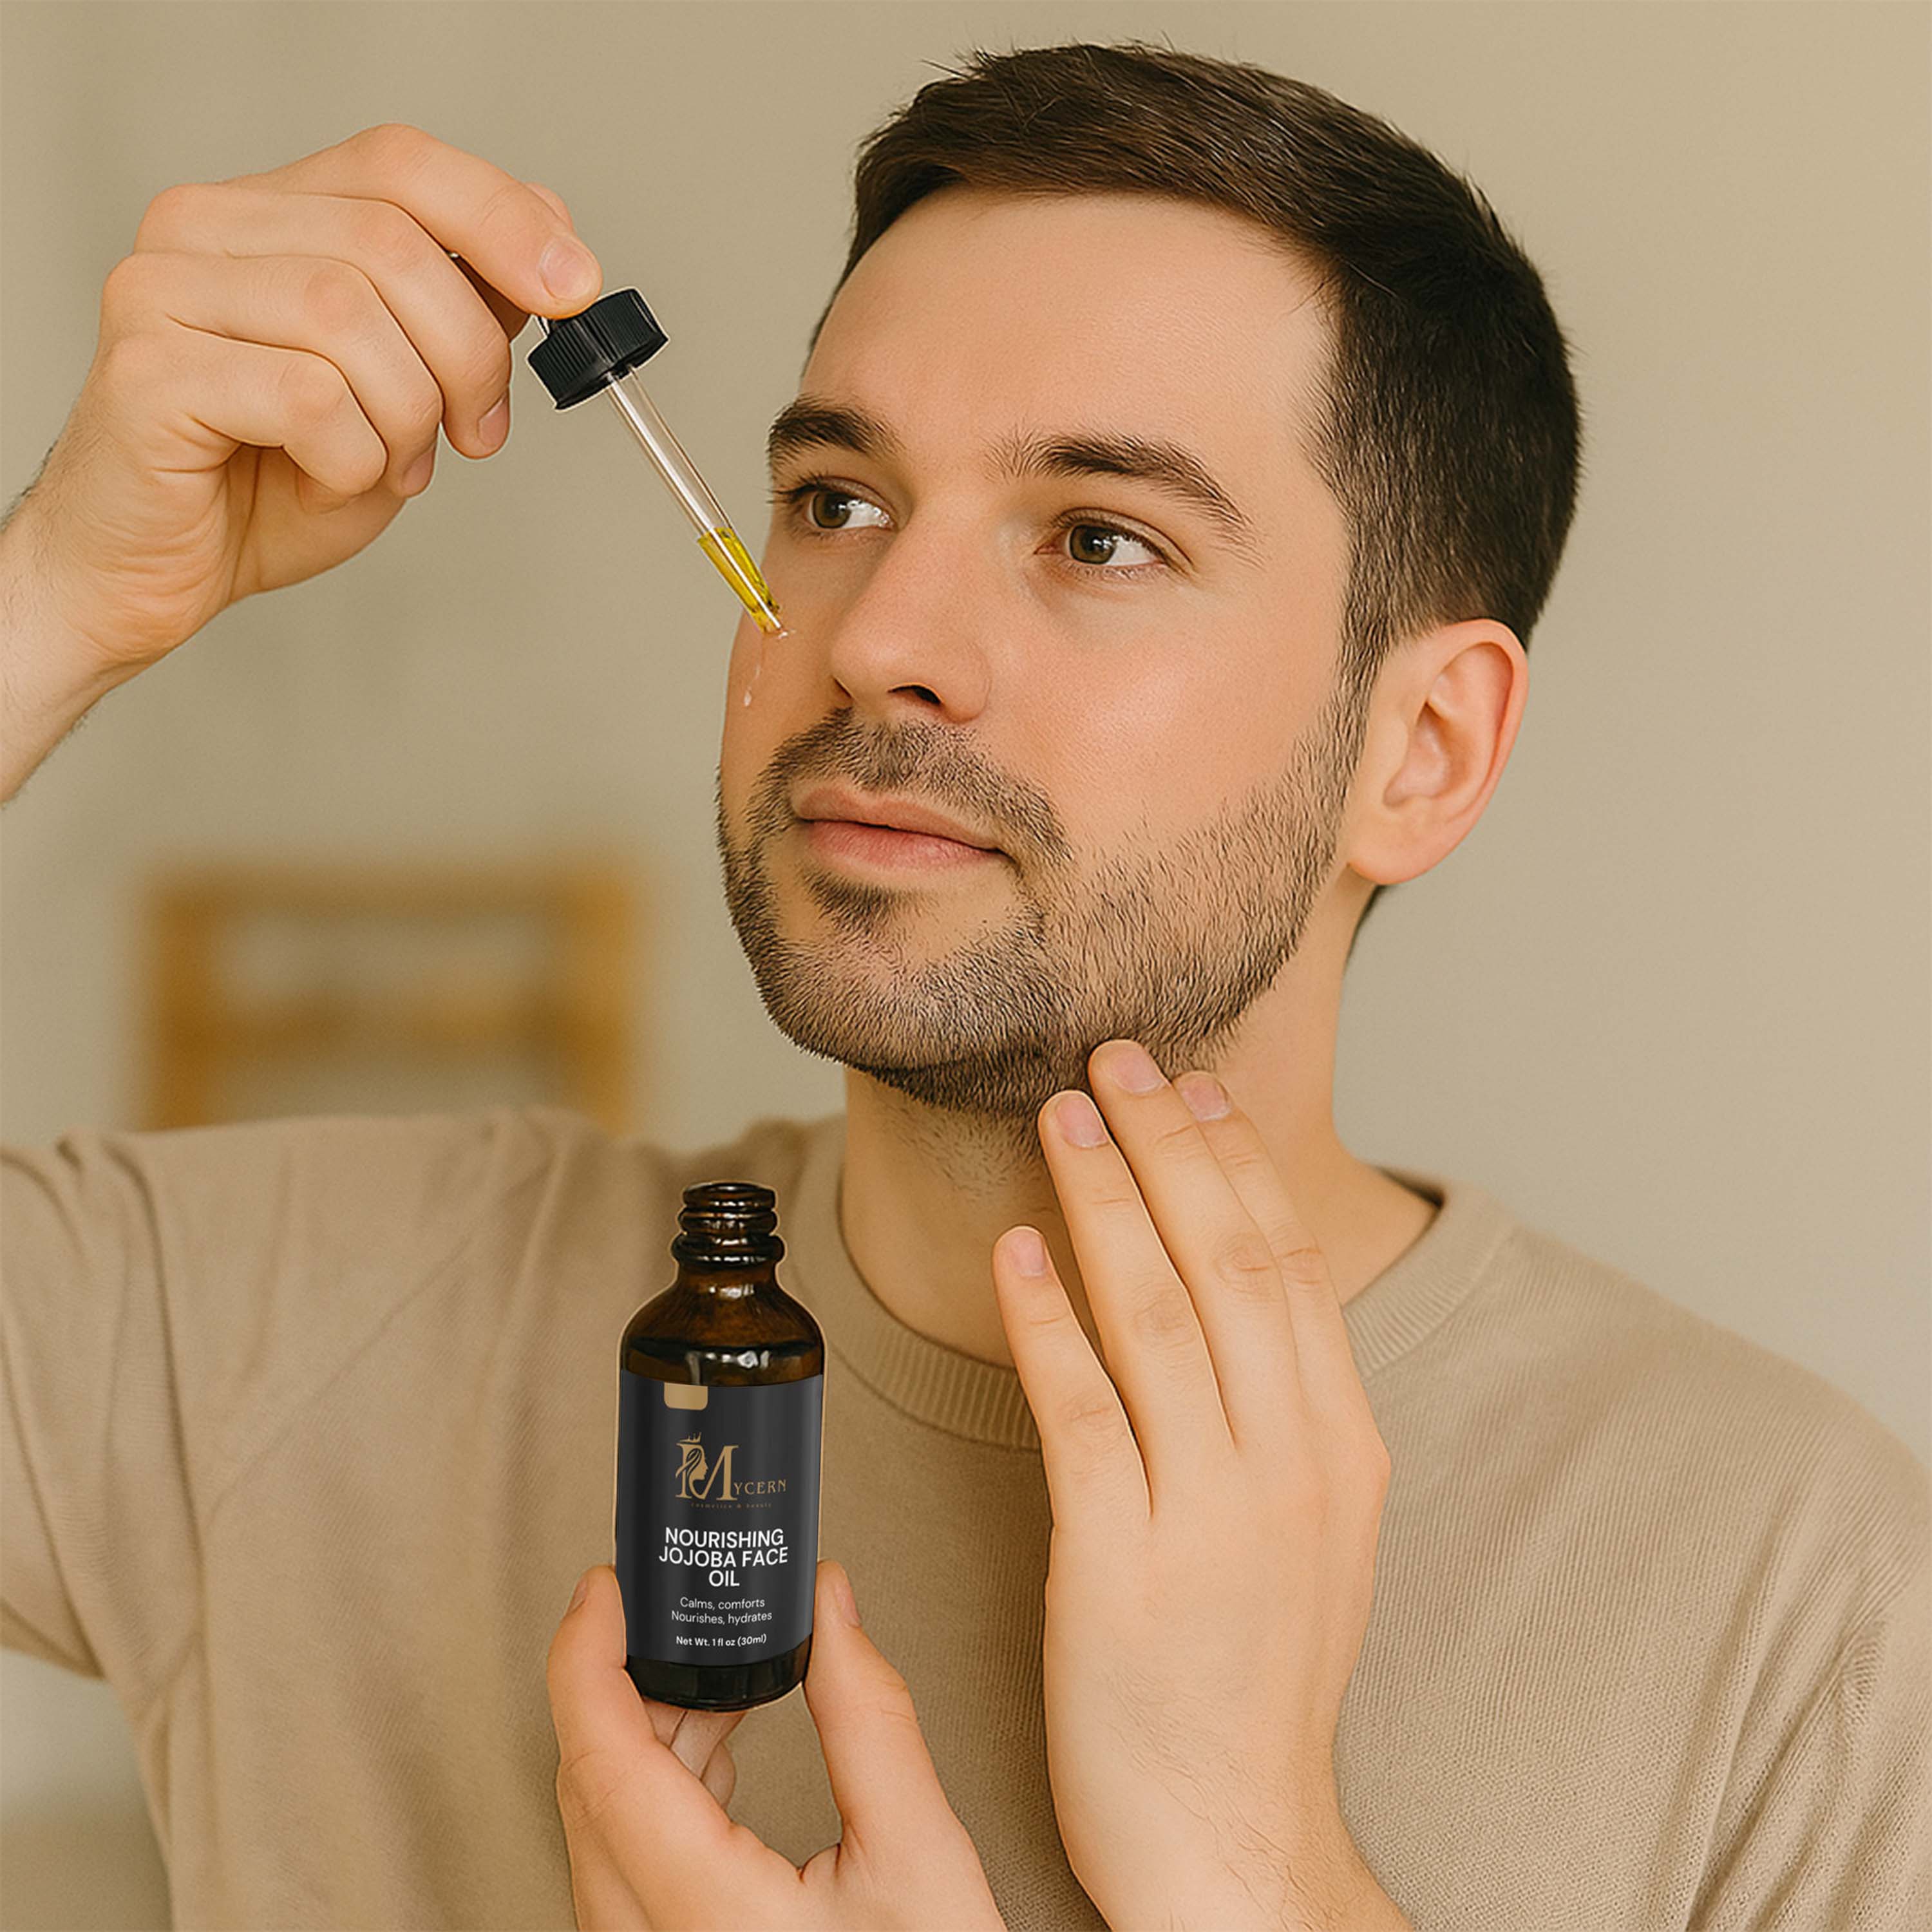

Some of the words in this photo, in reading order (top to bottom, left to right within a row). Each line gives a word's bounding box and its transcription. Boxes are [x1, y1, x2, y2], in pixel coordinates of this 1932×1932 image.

[665, 1526, 784, 1549] NOURISHING
[659, 1546, 737, 1567] JOJOBA
[742, 1546, 788, 1567] FACE
[708, 1569, 740, 1587] OIL
[680, 1596, 715, 1611] Calms,
[718, 1598, 765, 1610] comforts
[671, 1610, 725, 1625] Nourishes,
[728, 1612, 772, 1626] hydrates
[676, 1636, 692, 1646] Net
[694, 1638, 710, 1647] Wt.
[712, 1638, 716, 1647] 1
[717, 1638, 724, 1647] fl
[737, 1633, 767, 1647] (30ml)
